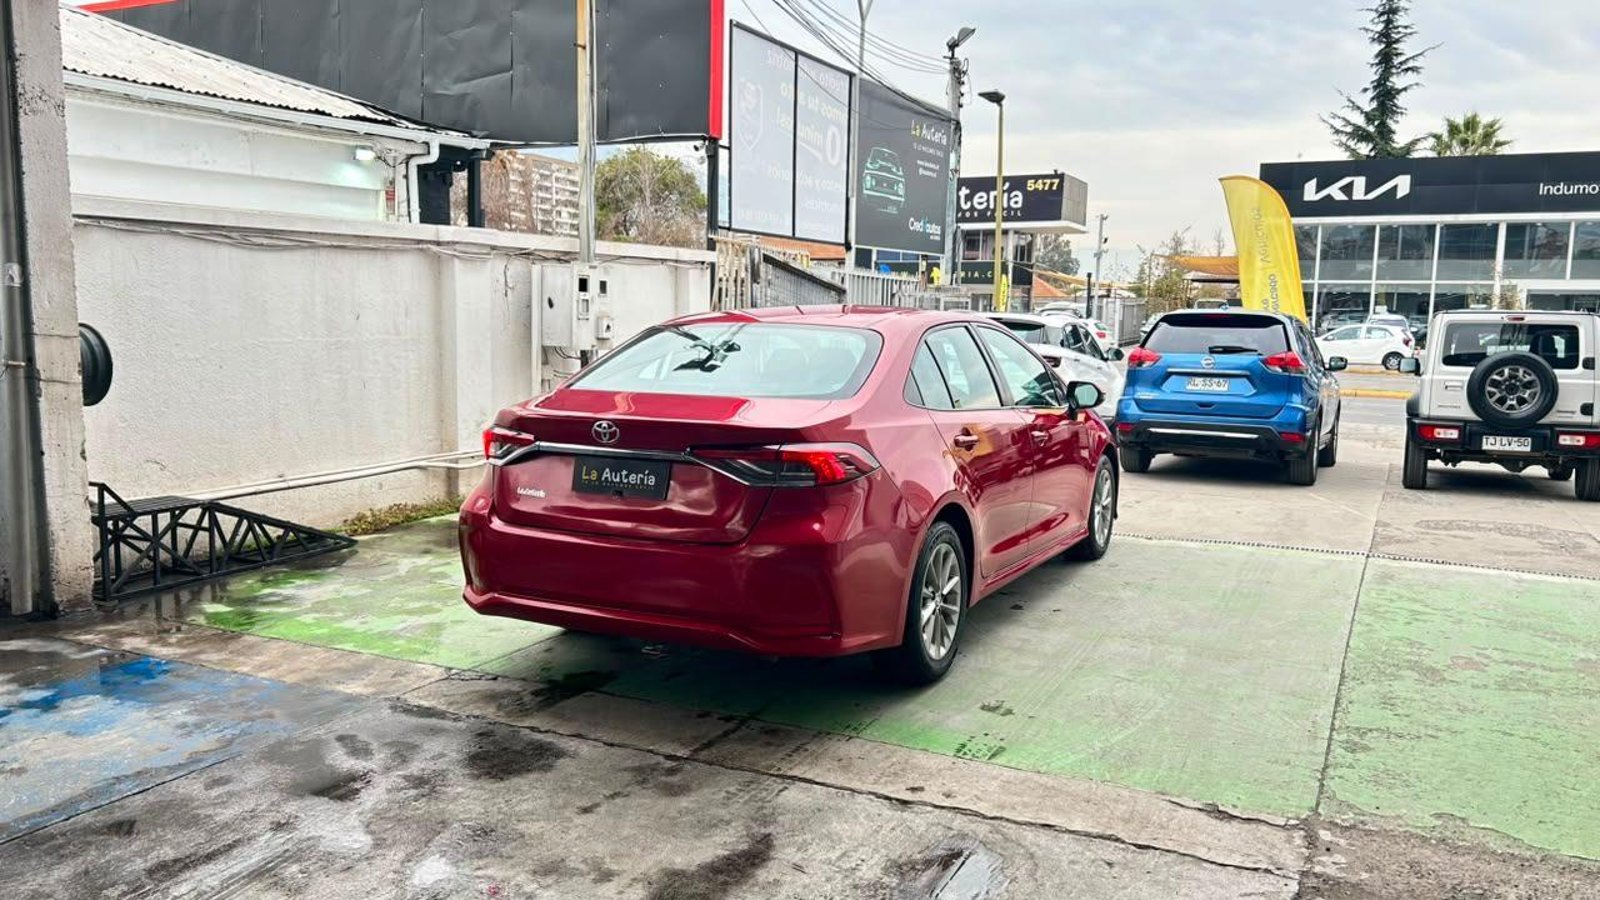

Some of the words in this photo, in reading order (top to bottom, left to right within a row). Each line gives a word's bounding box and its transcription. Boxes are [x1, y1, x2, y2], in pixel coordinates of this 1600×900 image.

[911, 119, 921, 137] La
[1026, 178, 1060, 191] 5477
[1303, 174, 1411, 202] KIA
[1539, 181, 1600, 196] Indumo
[582, 465, 598, 481] La
[601, 467, 656, 486] Autería
